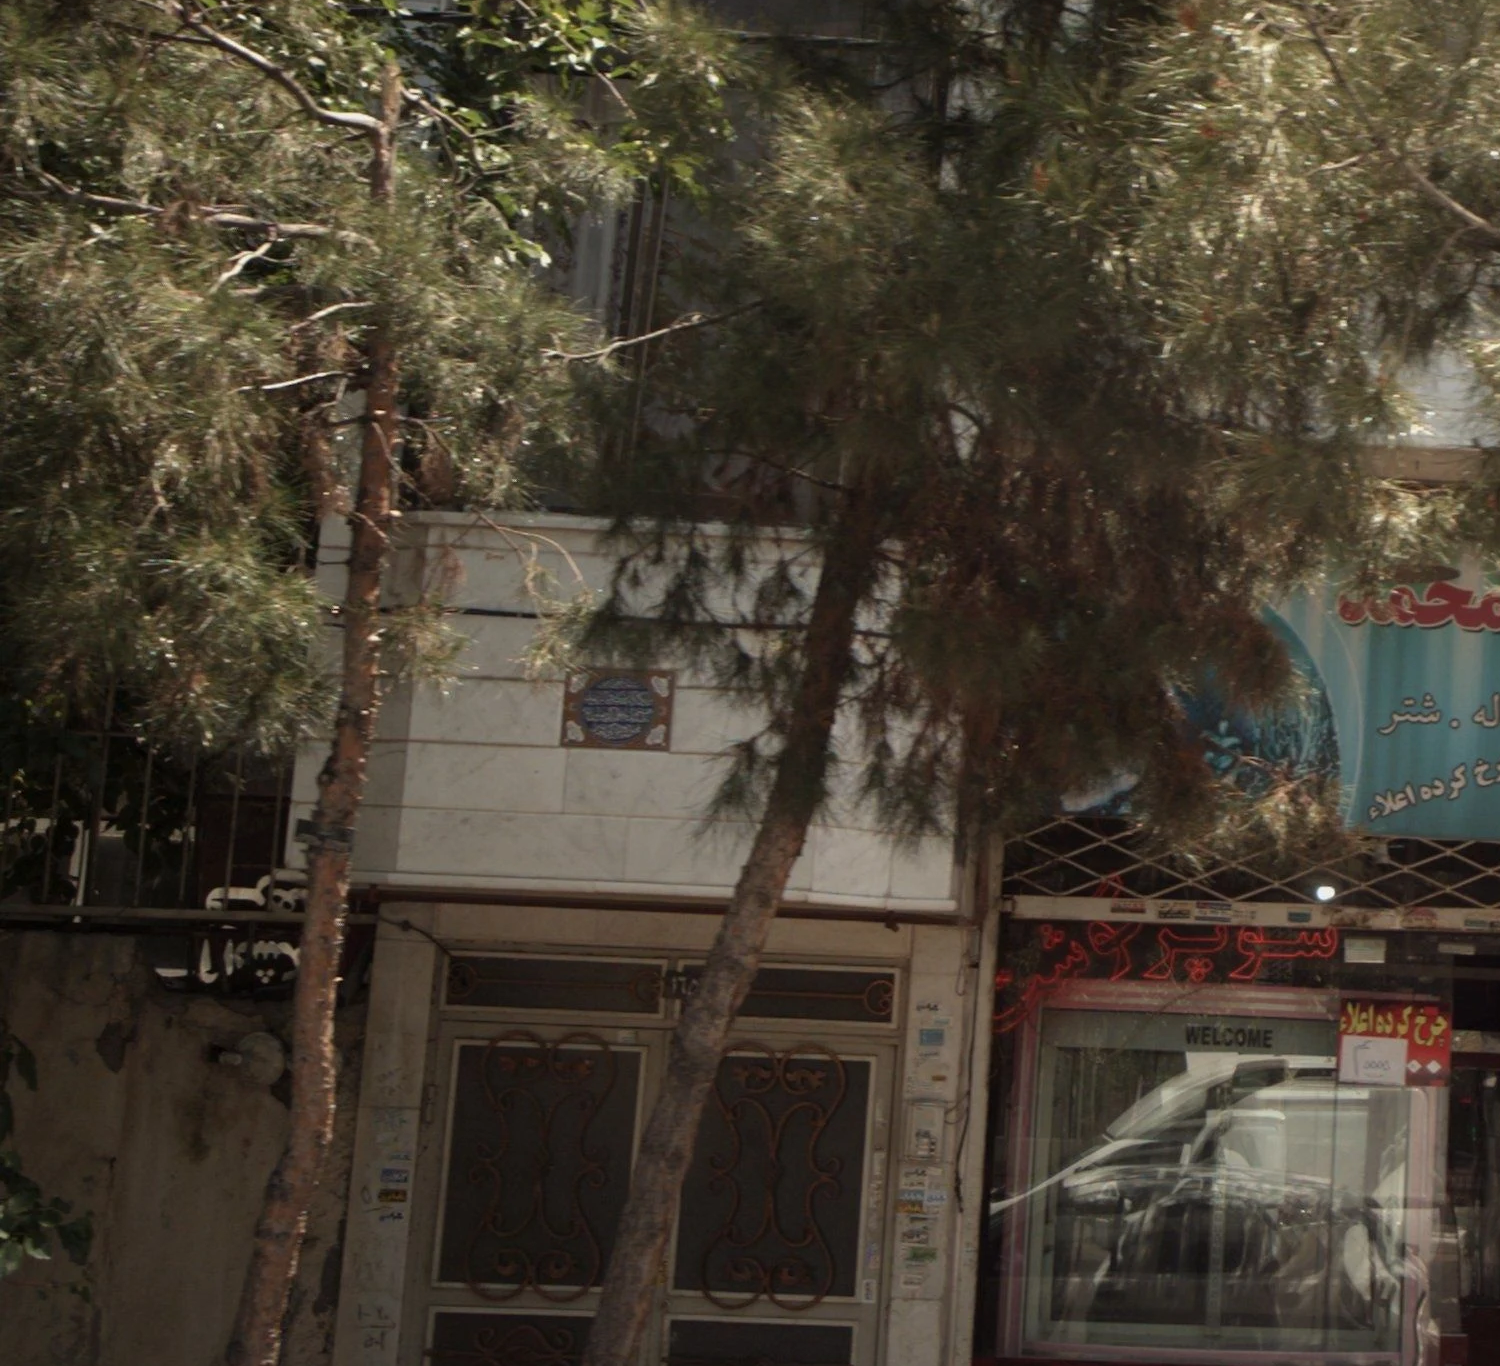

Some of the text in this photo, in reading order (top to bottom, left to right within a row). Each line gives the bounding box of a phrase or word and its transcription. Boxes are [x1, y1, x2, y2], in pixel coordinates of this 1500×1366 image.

[1378, 693, 1441, 735] شتر
[1418, 763, 1467, 800] کرده
[1142, 925, 1338, 982] سوپر
[1184, 1024, 1274, 1050] WELCOME
[1375, 1005, 1413, 1039] کده
[1414, 1007, 1449, 1046] چرخ
